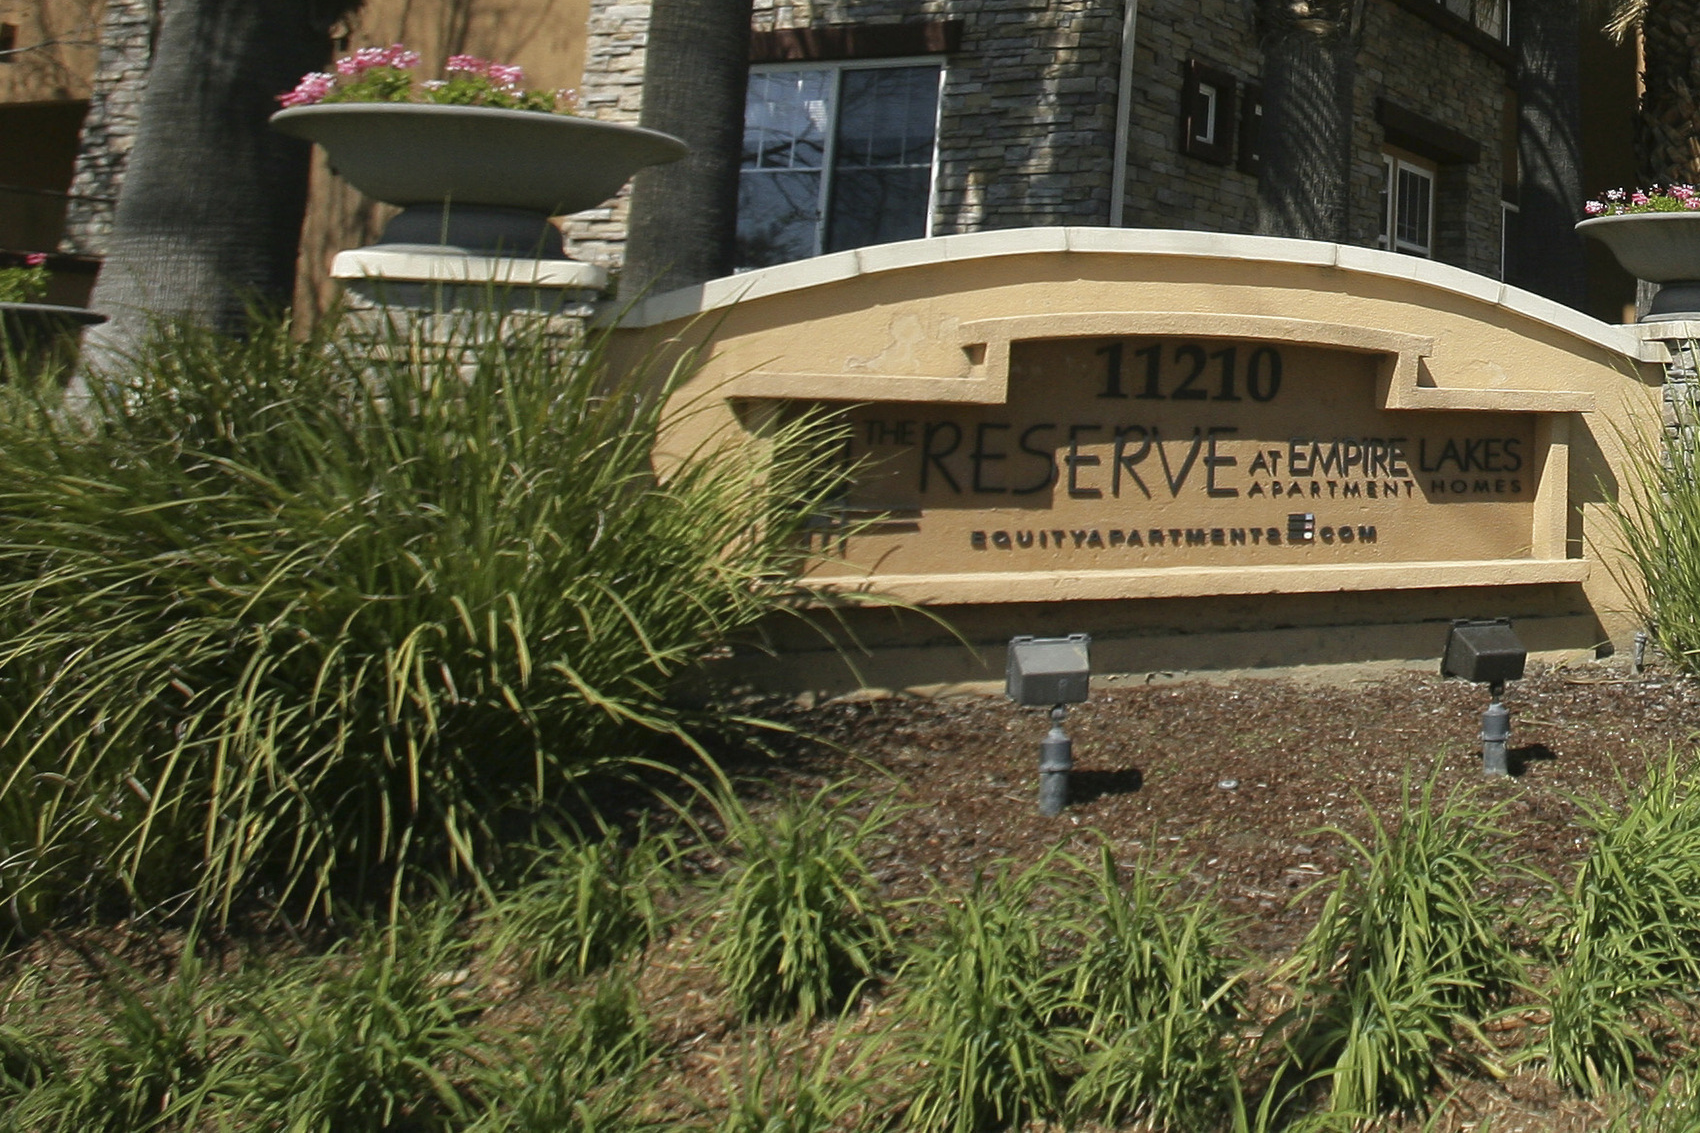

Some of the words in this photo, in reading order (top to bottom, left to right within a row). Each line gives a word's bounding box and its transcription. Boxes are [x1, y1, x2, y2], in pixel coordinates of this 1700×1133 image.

[1096, 343, 1282, 402] 11210
[864, 419, 916, 446] THE
[919, 422, 1239, 498] RESERVE
[1248, 449, 1283, 477] AT
[1288, 436, 1409, 478] EMPIRE
[1419, 437, 1522, 473] LAKES
[1247, 479, 1415, 499] APARTMENT
[1431, 478, 1522, 494] HOMES
